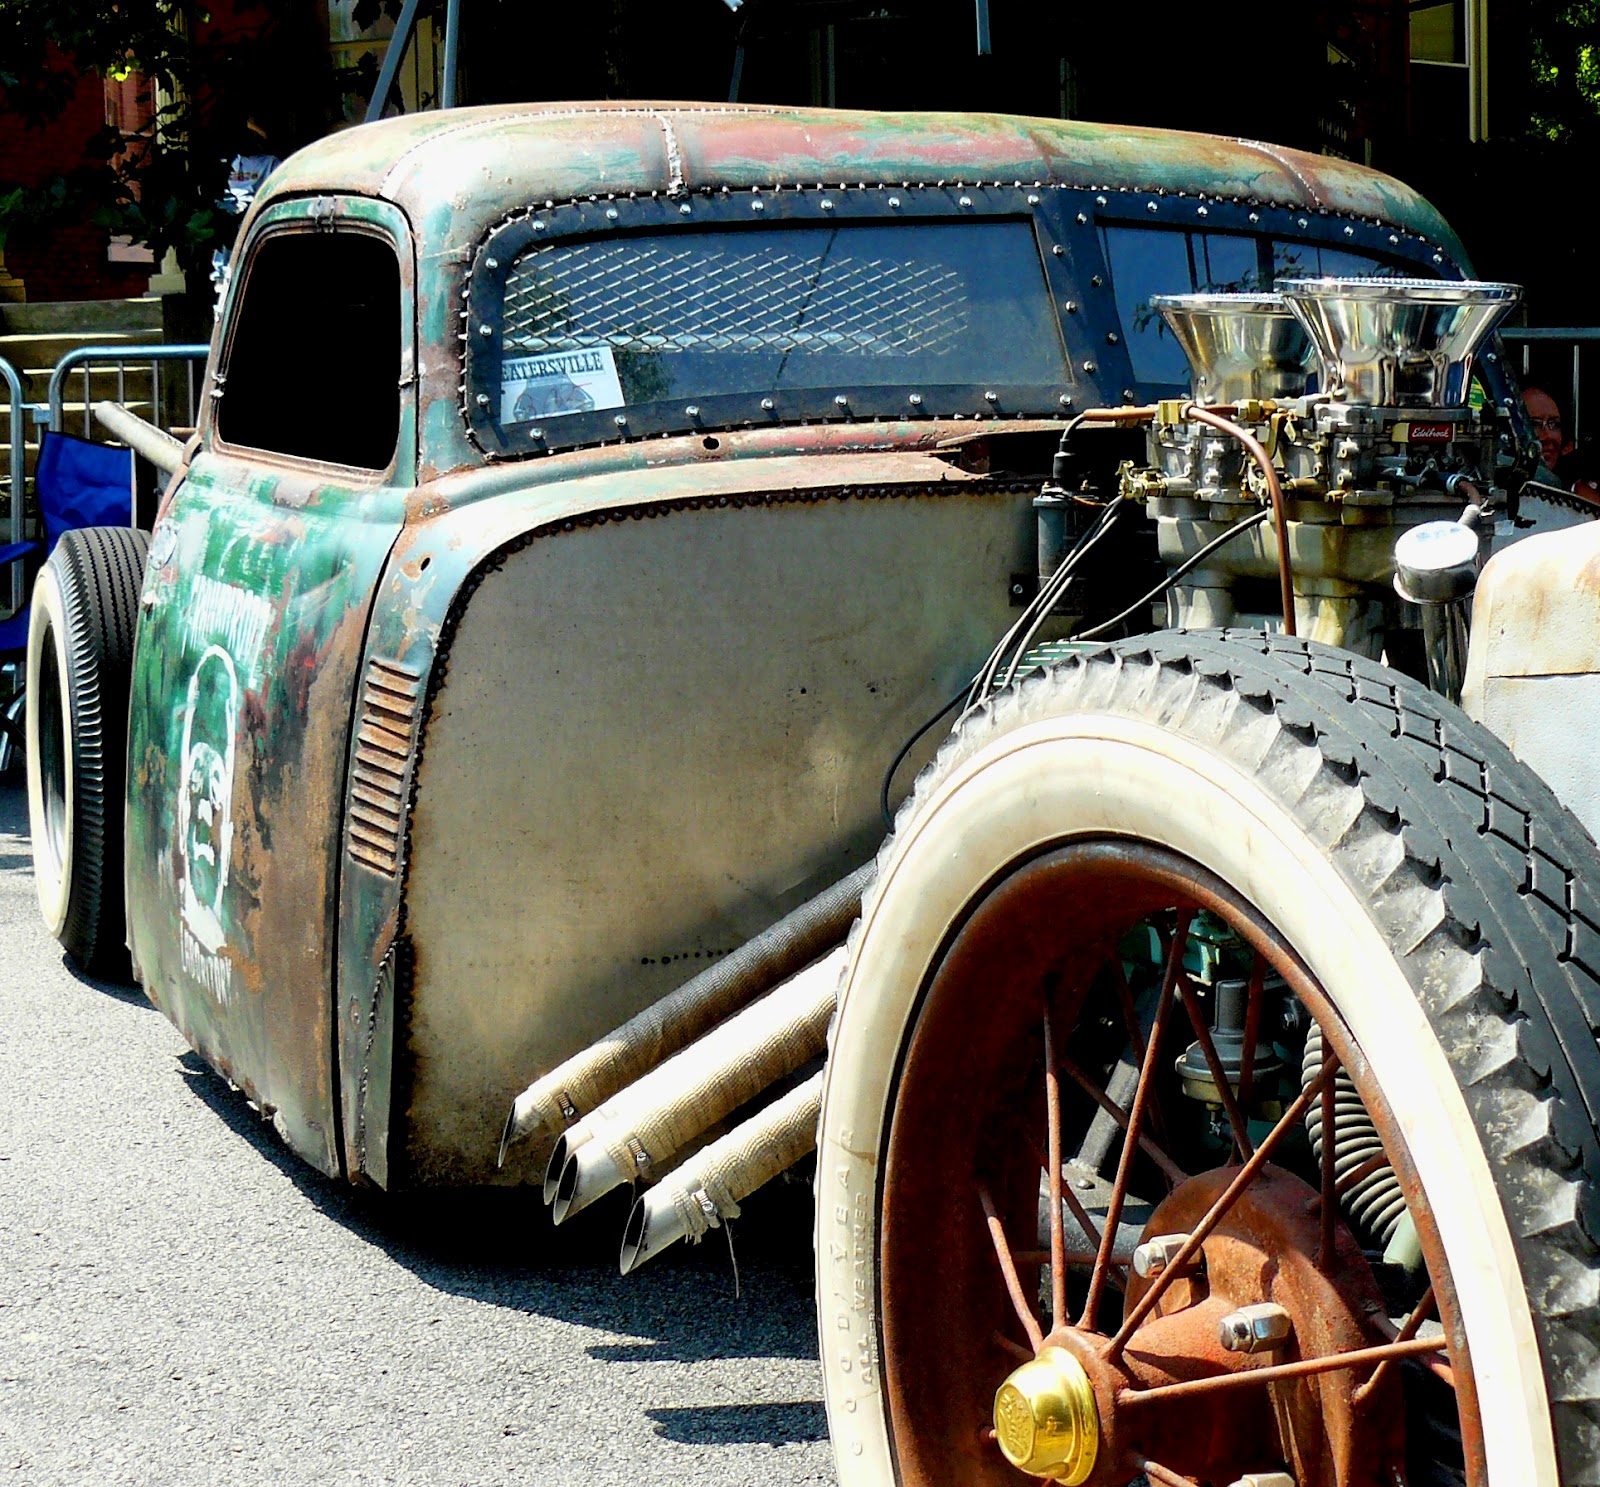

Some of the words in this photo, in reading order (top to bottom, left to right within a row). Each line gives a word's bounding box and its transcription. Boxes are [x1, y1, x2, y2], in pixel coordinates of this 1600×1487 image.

[1411, 427, 1450, 438] Edelbrock
[852, 1192, 869, 1311] WEATHER
[857, 1333, 873, 1385] ALL
